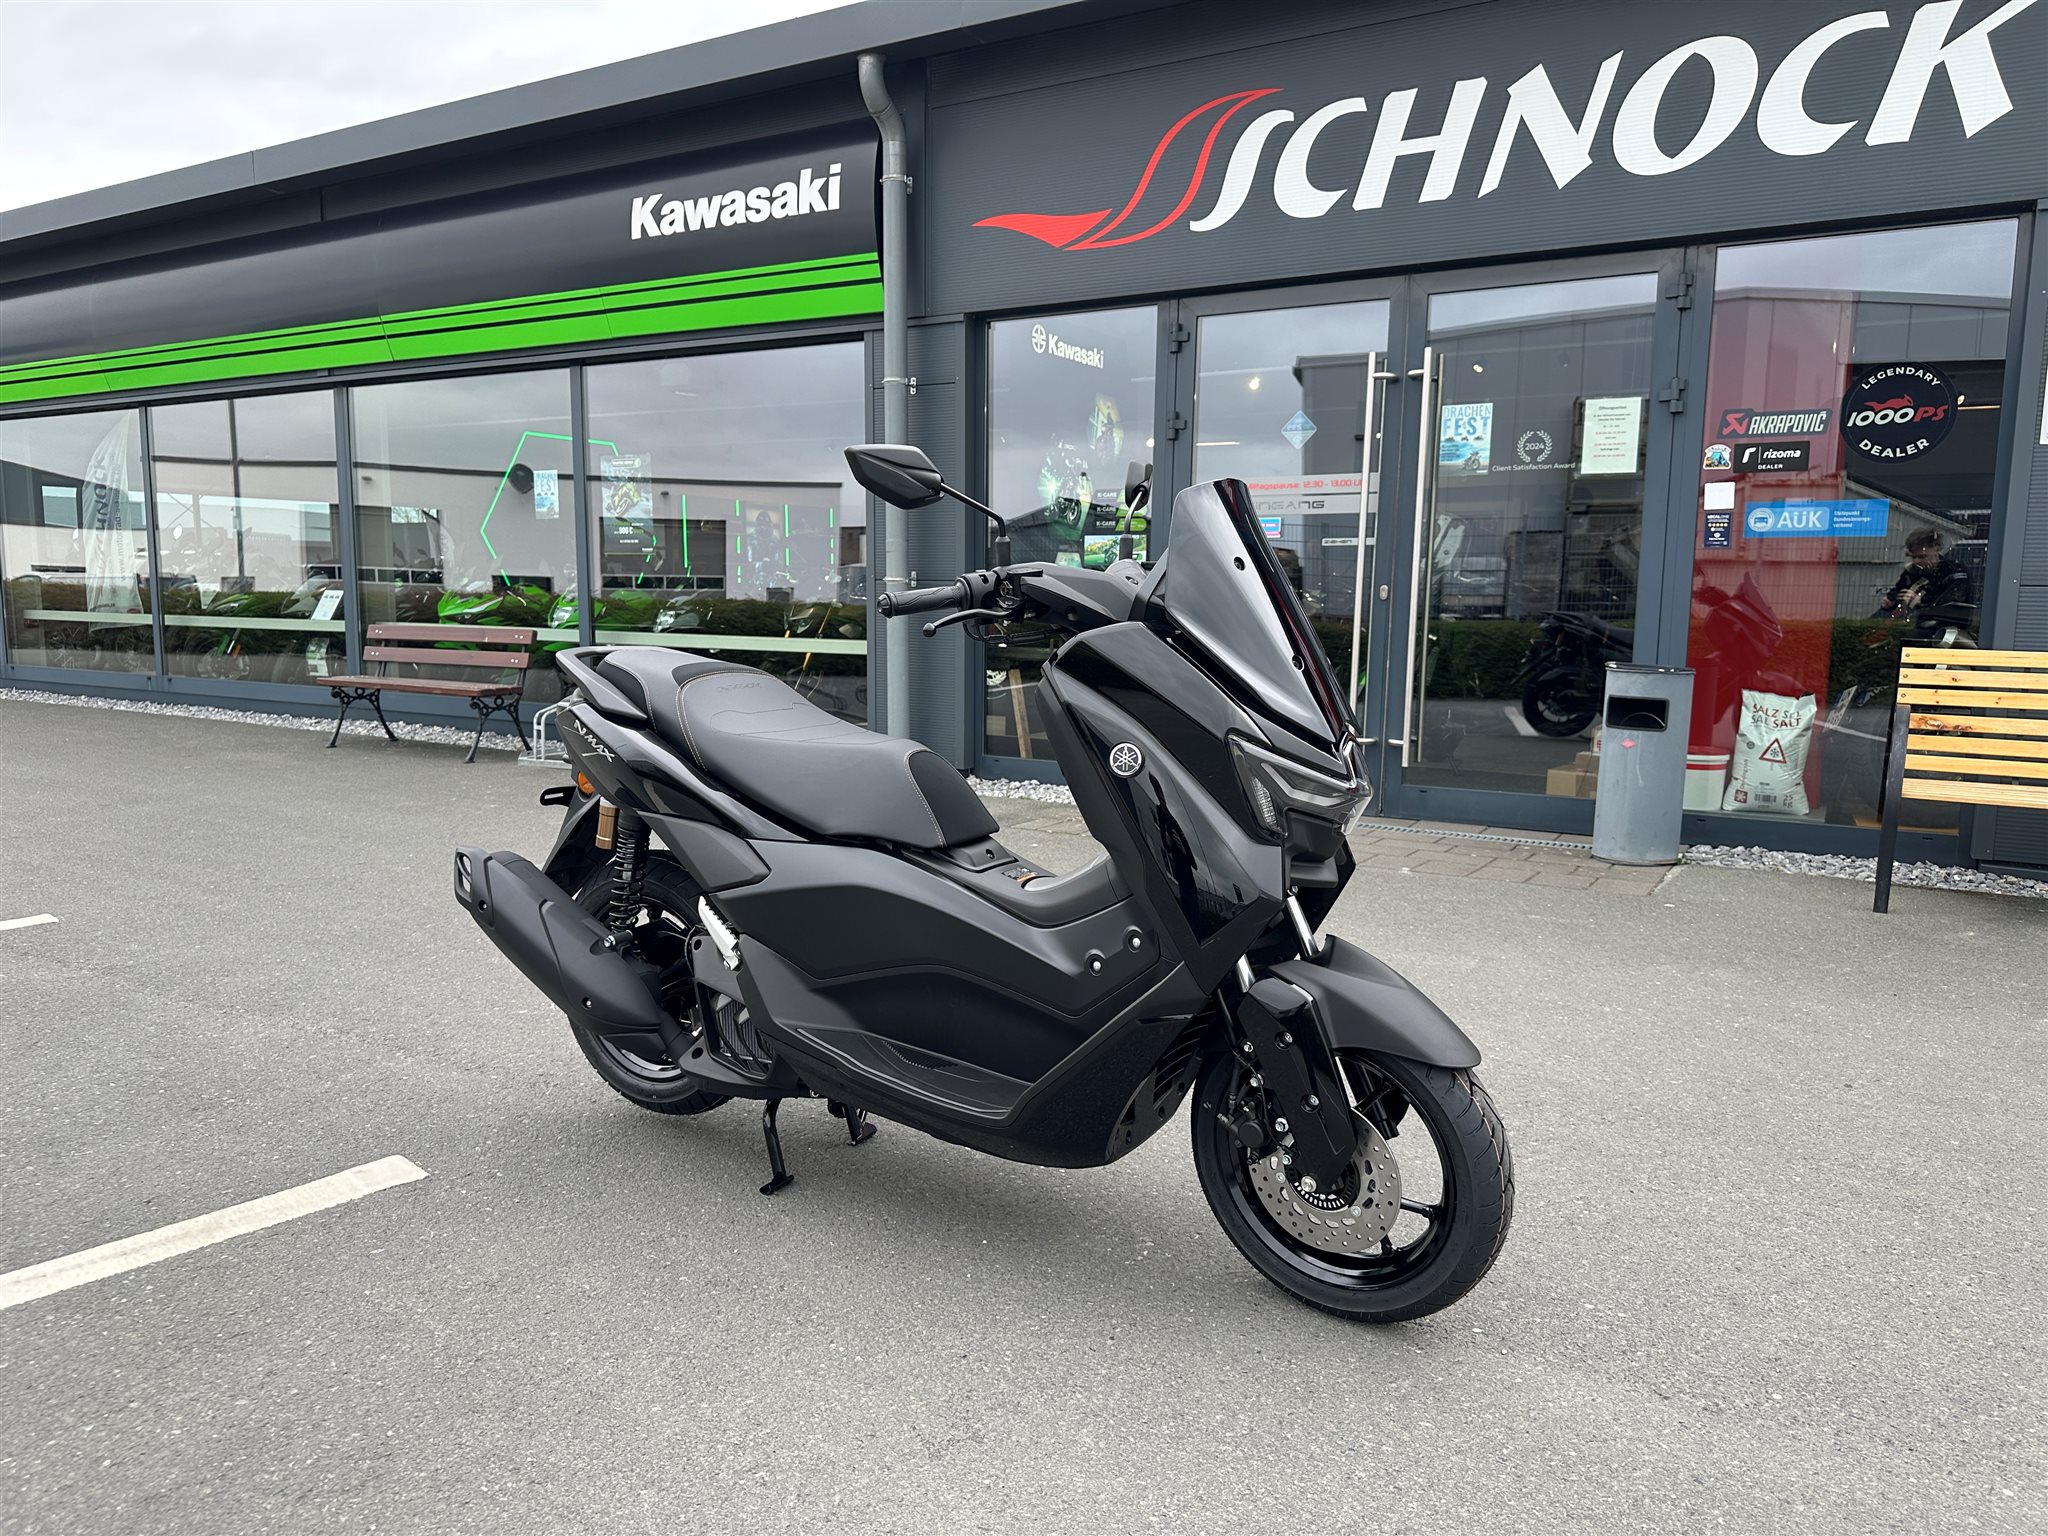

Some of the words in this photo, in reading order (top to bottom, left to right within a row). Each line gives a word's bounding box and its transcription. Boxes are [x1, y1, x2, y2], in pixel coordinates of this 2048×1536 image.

[631, 162, 842, 240] Kawasaki
[1048, 333, 1104, 369] Kawasaki
[1861, 366, 1941, 390] LEGENDARY
[1443, 404, 1492, 418] DRACHEN
[1847, 404, 1949, 427] 1000PS
[1442, 416, 1490, 437] FEST
[1762, 448, 1802, 459] rizoma
[1859, 438, 1930, 458] DEALER
[1512, 463, 1552, 471] Satisfaction
[1752, 703, 1779, 718] SALZ
[1751, 714, 1770, 726] SAL
[1773, 717, 1801, 729] SALT
